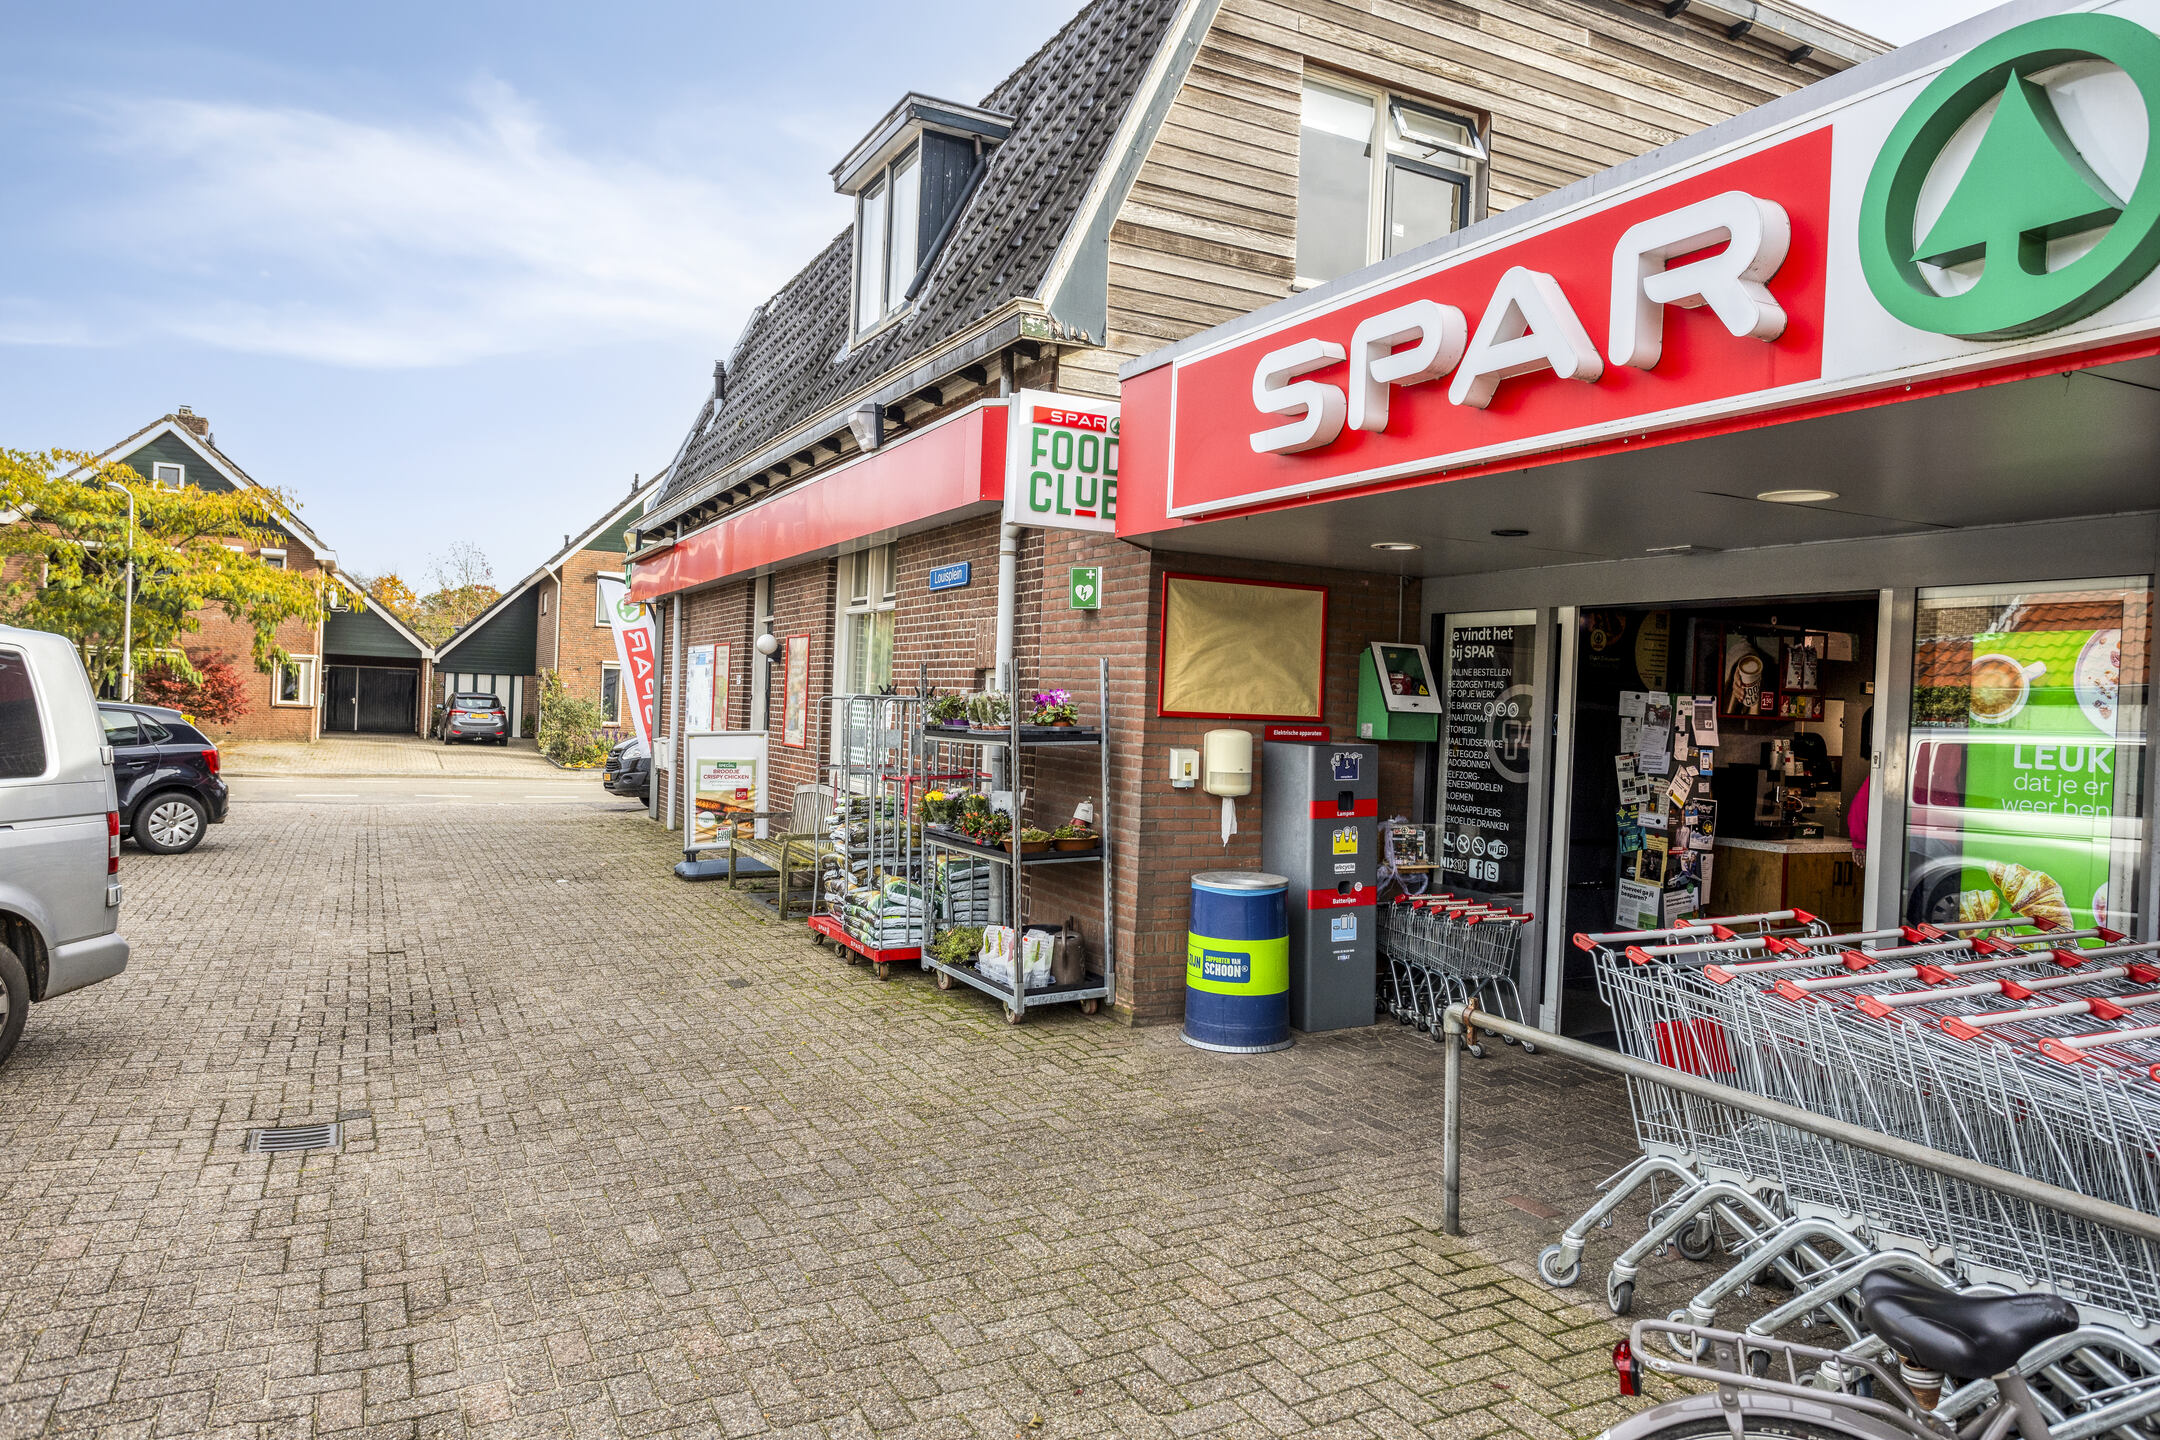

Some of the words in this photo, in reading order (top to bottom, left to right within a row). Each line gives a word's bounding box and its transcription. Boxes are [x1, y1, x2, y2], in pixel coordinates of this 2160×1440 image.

[1249, 190, 1792, 455] SPAR
[1050, 410, 1106, 429] SPAR
[1030, 427, 1120, 477] FOOD
[1029, 470, 1118, 520] CLUB
[934, 568, 963, 585] Louisplein
[1461, 627, 1491, 641] vindt
[1493, 627, 1513, 640] het
[1464, 645, 1495, 658] SPAR
[1473, 668, 1511, 677] BESTELLEN
[1484, 681, 1504, 689] THUIS
[1476, 690, 1496, 698] WERK
[1457, 702, 1482, 710] BAKKER
[1484, 751, 1490, 760] &
[2012, 743, 2113, 774] LEUK
[1446, 759, 1491, 769] ADOBONNEN
[1446, 771, 1481, 780] ELFZORG-
[2013, 772, 2051, 792] dat
[2053, 774, 2078, 798] je
[2083, 779, 2110, 796] er
[1446, 792, 1474, 802] LOEMEN
[2063, 798, 2113, 817] ben
[1476, 820, 1510, 831] DRANKEN
[1205, 955, 1230, 965] SUPPORTER
